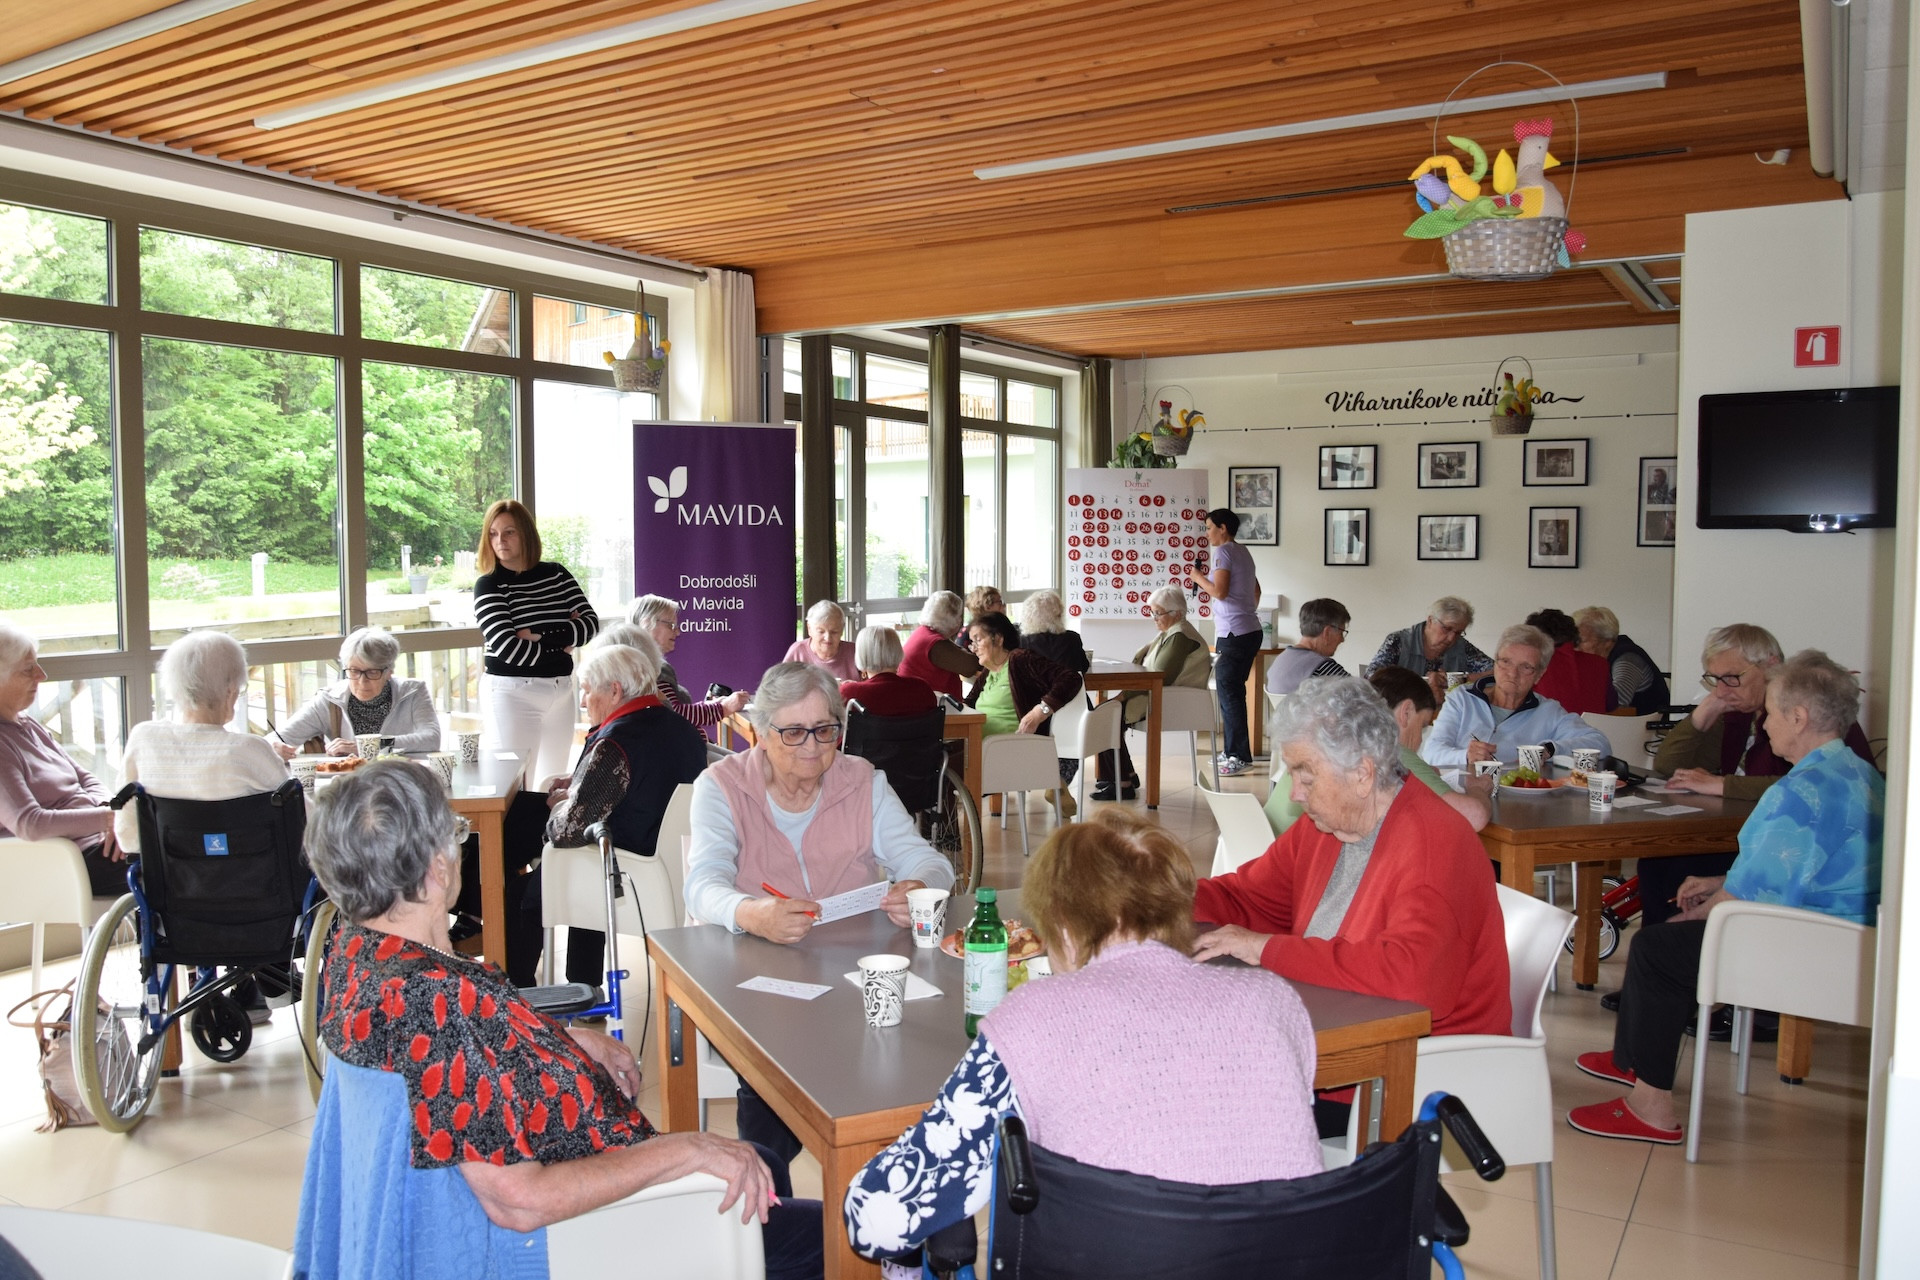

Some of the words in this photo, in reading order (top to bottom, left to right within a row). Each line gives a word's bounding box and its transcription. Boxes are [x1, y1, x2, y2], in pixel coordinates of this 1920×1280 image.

[1325, 388, 1458, 412] Viharnikove
[1462, 386, 1502, 407] niti
[678, 504, 784, 526] MAVIDA
[680, 574, 757, 588] Dobrodošli
[679, 600, 688, 610] v
[693, 597, 744, 610] Mavida
[680, 618, 732, 632] družini.
